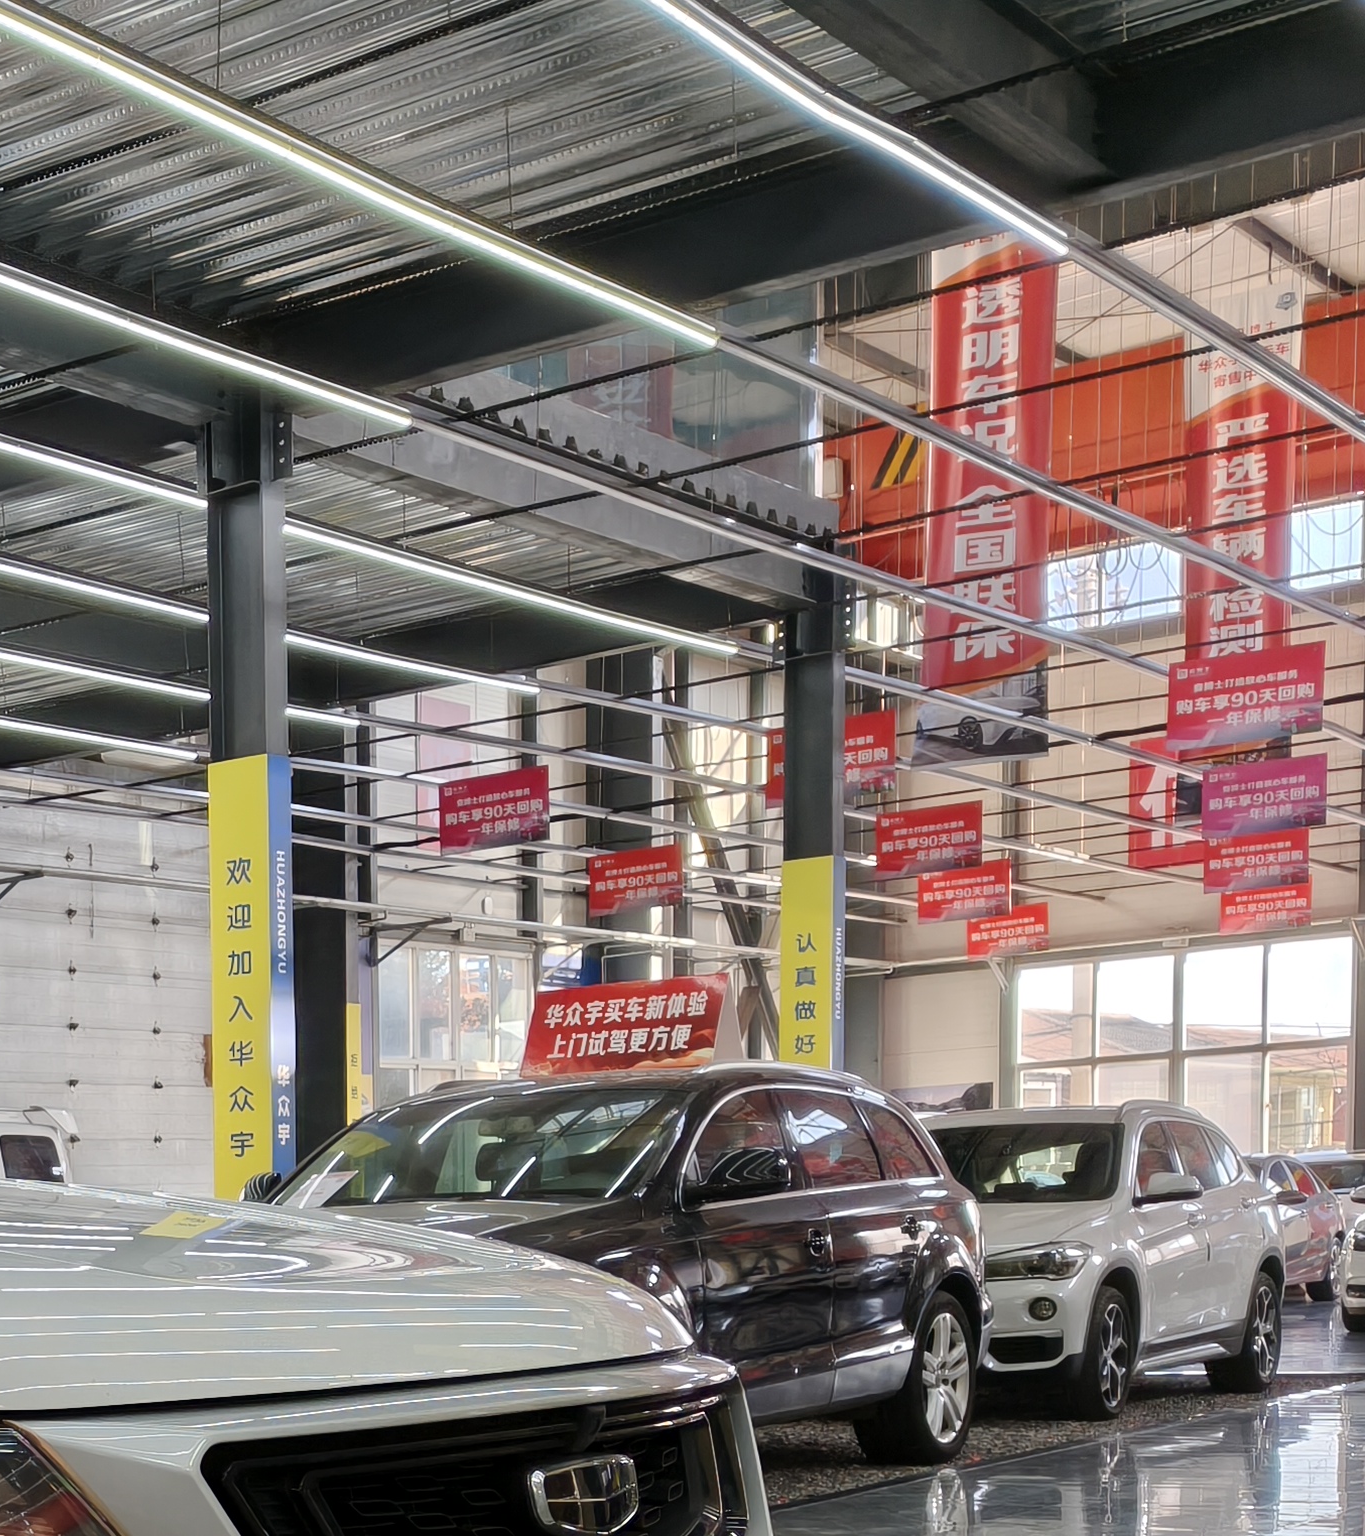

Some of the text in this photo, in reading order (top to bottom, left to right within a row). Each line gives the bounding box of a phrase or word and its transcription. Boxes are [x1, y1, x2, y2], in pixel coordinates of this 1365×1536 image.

[956, 277, 1023, 463] 透明车况
[1209, 412, 1270, 660] 严选车辆 检测
[950, 485, 1017, 662] 全国联保
[1175, 682, 1315, 716] 购车享90天回购
[1206, 706, 1282, 727] 一年保修
[445, 798, 544, 827] 购车享90天回购
[1209, 785, 1320, 811] 购车享90天回购
[1233, 805, 1294, 819] 一年保修
[467, 817, 520, 835] 一年保修
[881, 830, 977, 853] 购车享90天回购
[902, 846, 955, 861] 一年保修
[1209, 850, 1304, 871] 购车享90天回购
[922, 883, 1007, 903] 购车享90天回购
[1225, 897, 1308, 915] 购车享90天回购
[275, 850, 288, 975] HUAZHONGYU
[225, 857, 255, 1158] 欢迎加入华众宇
[794, 932, 817, 1055] 认真做好
[544, 990, 709, 1029] 华众宇买车新体验
[546, 1024, 693, 1060] 上门试驾更方便
[276, 1064, 291, 1146] 华众宇
